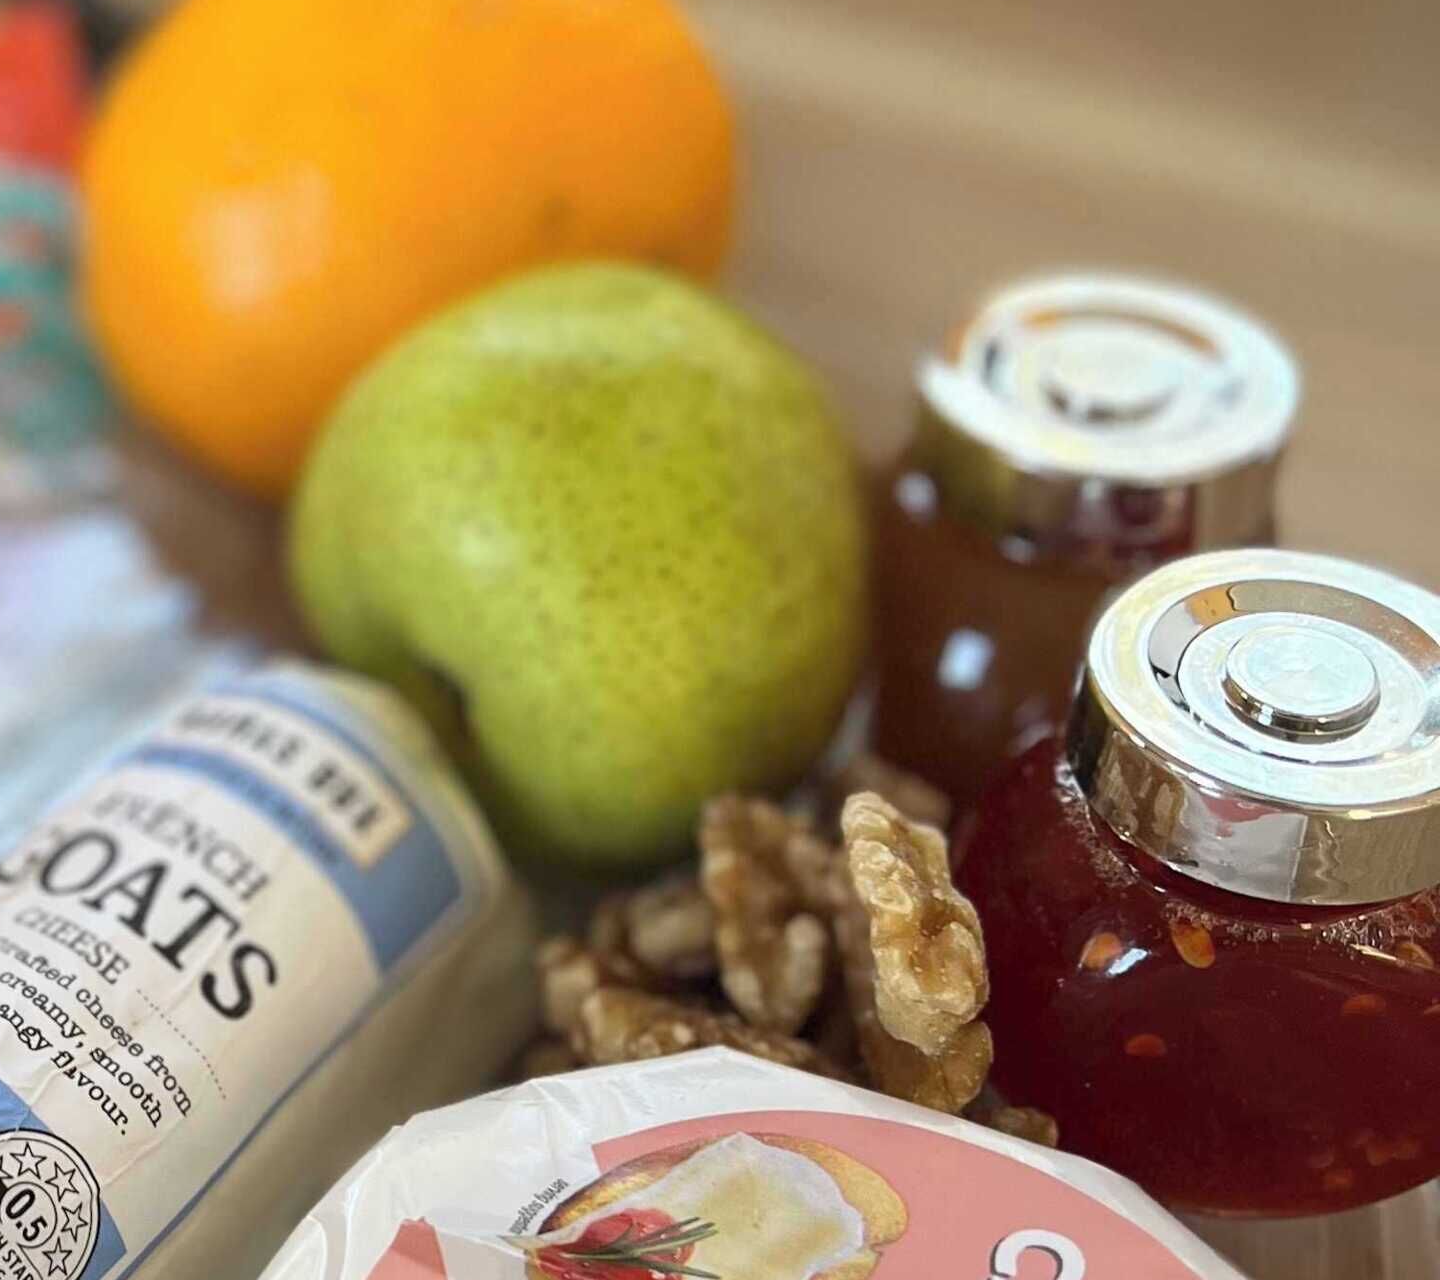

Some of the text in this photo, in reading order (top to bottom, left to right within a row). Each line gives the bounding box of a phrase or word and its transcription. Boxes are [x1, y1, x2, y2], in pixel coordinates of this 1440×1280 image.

[92, 788, 270, 902] FRENCH
[13, 905, 131, 986] CHEESE
[75, 988, 144, 1057] cheese
[143, 1050, 193, 1117] from
[88, 1046, 163, 1128] smooth
[5, 1187, 49, 1242] 0.5
